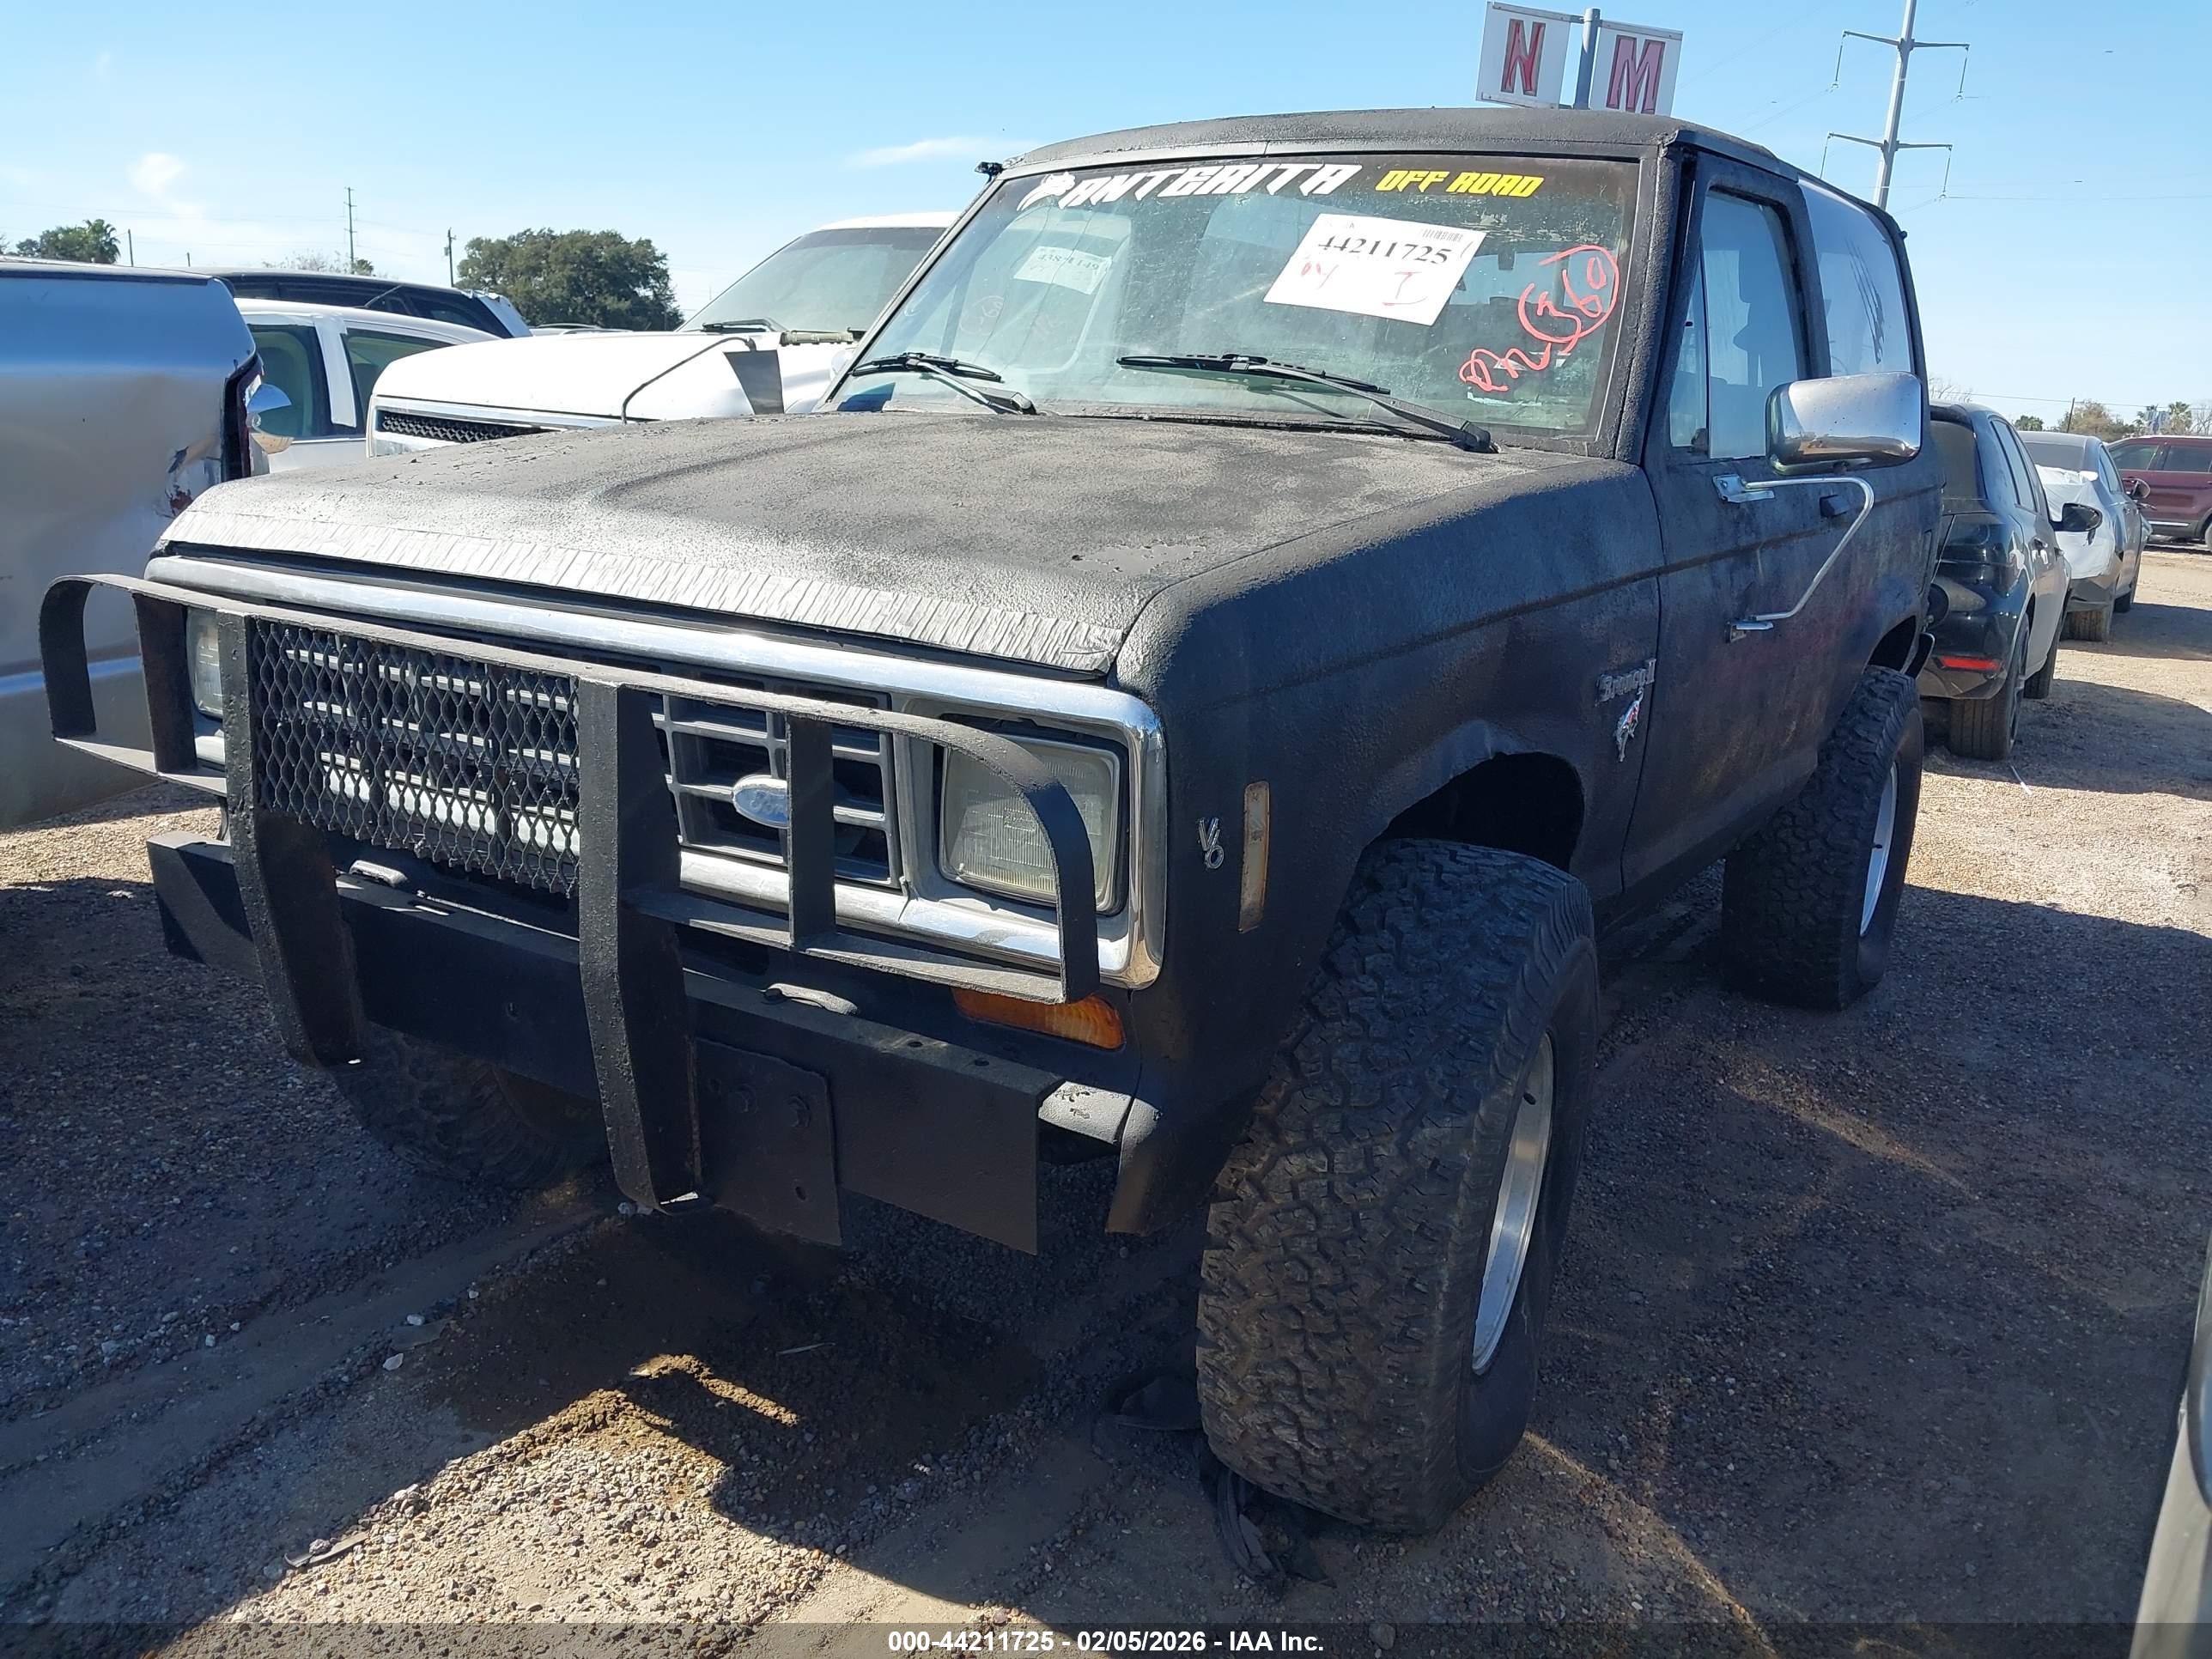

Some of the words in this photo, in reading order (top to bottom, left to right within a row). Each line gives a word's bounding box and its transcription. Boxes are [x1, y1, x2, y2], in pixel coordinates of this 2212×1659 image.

[1500, 18, 1547, 97] N
[1606, 34, 1666, 114] M
[1375, 170, 1450, 193] OFF
[1445, 172, 1545, 198] ROAD
[1318, 234, 1452, 264] 44211725
[1197, 817, 1224, 870] V6
